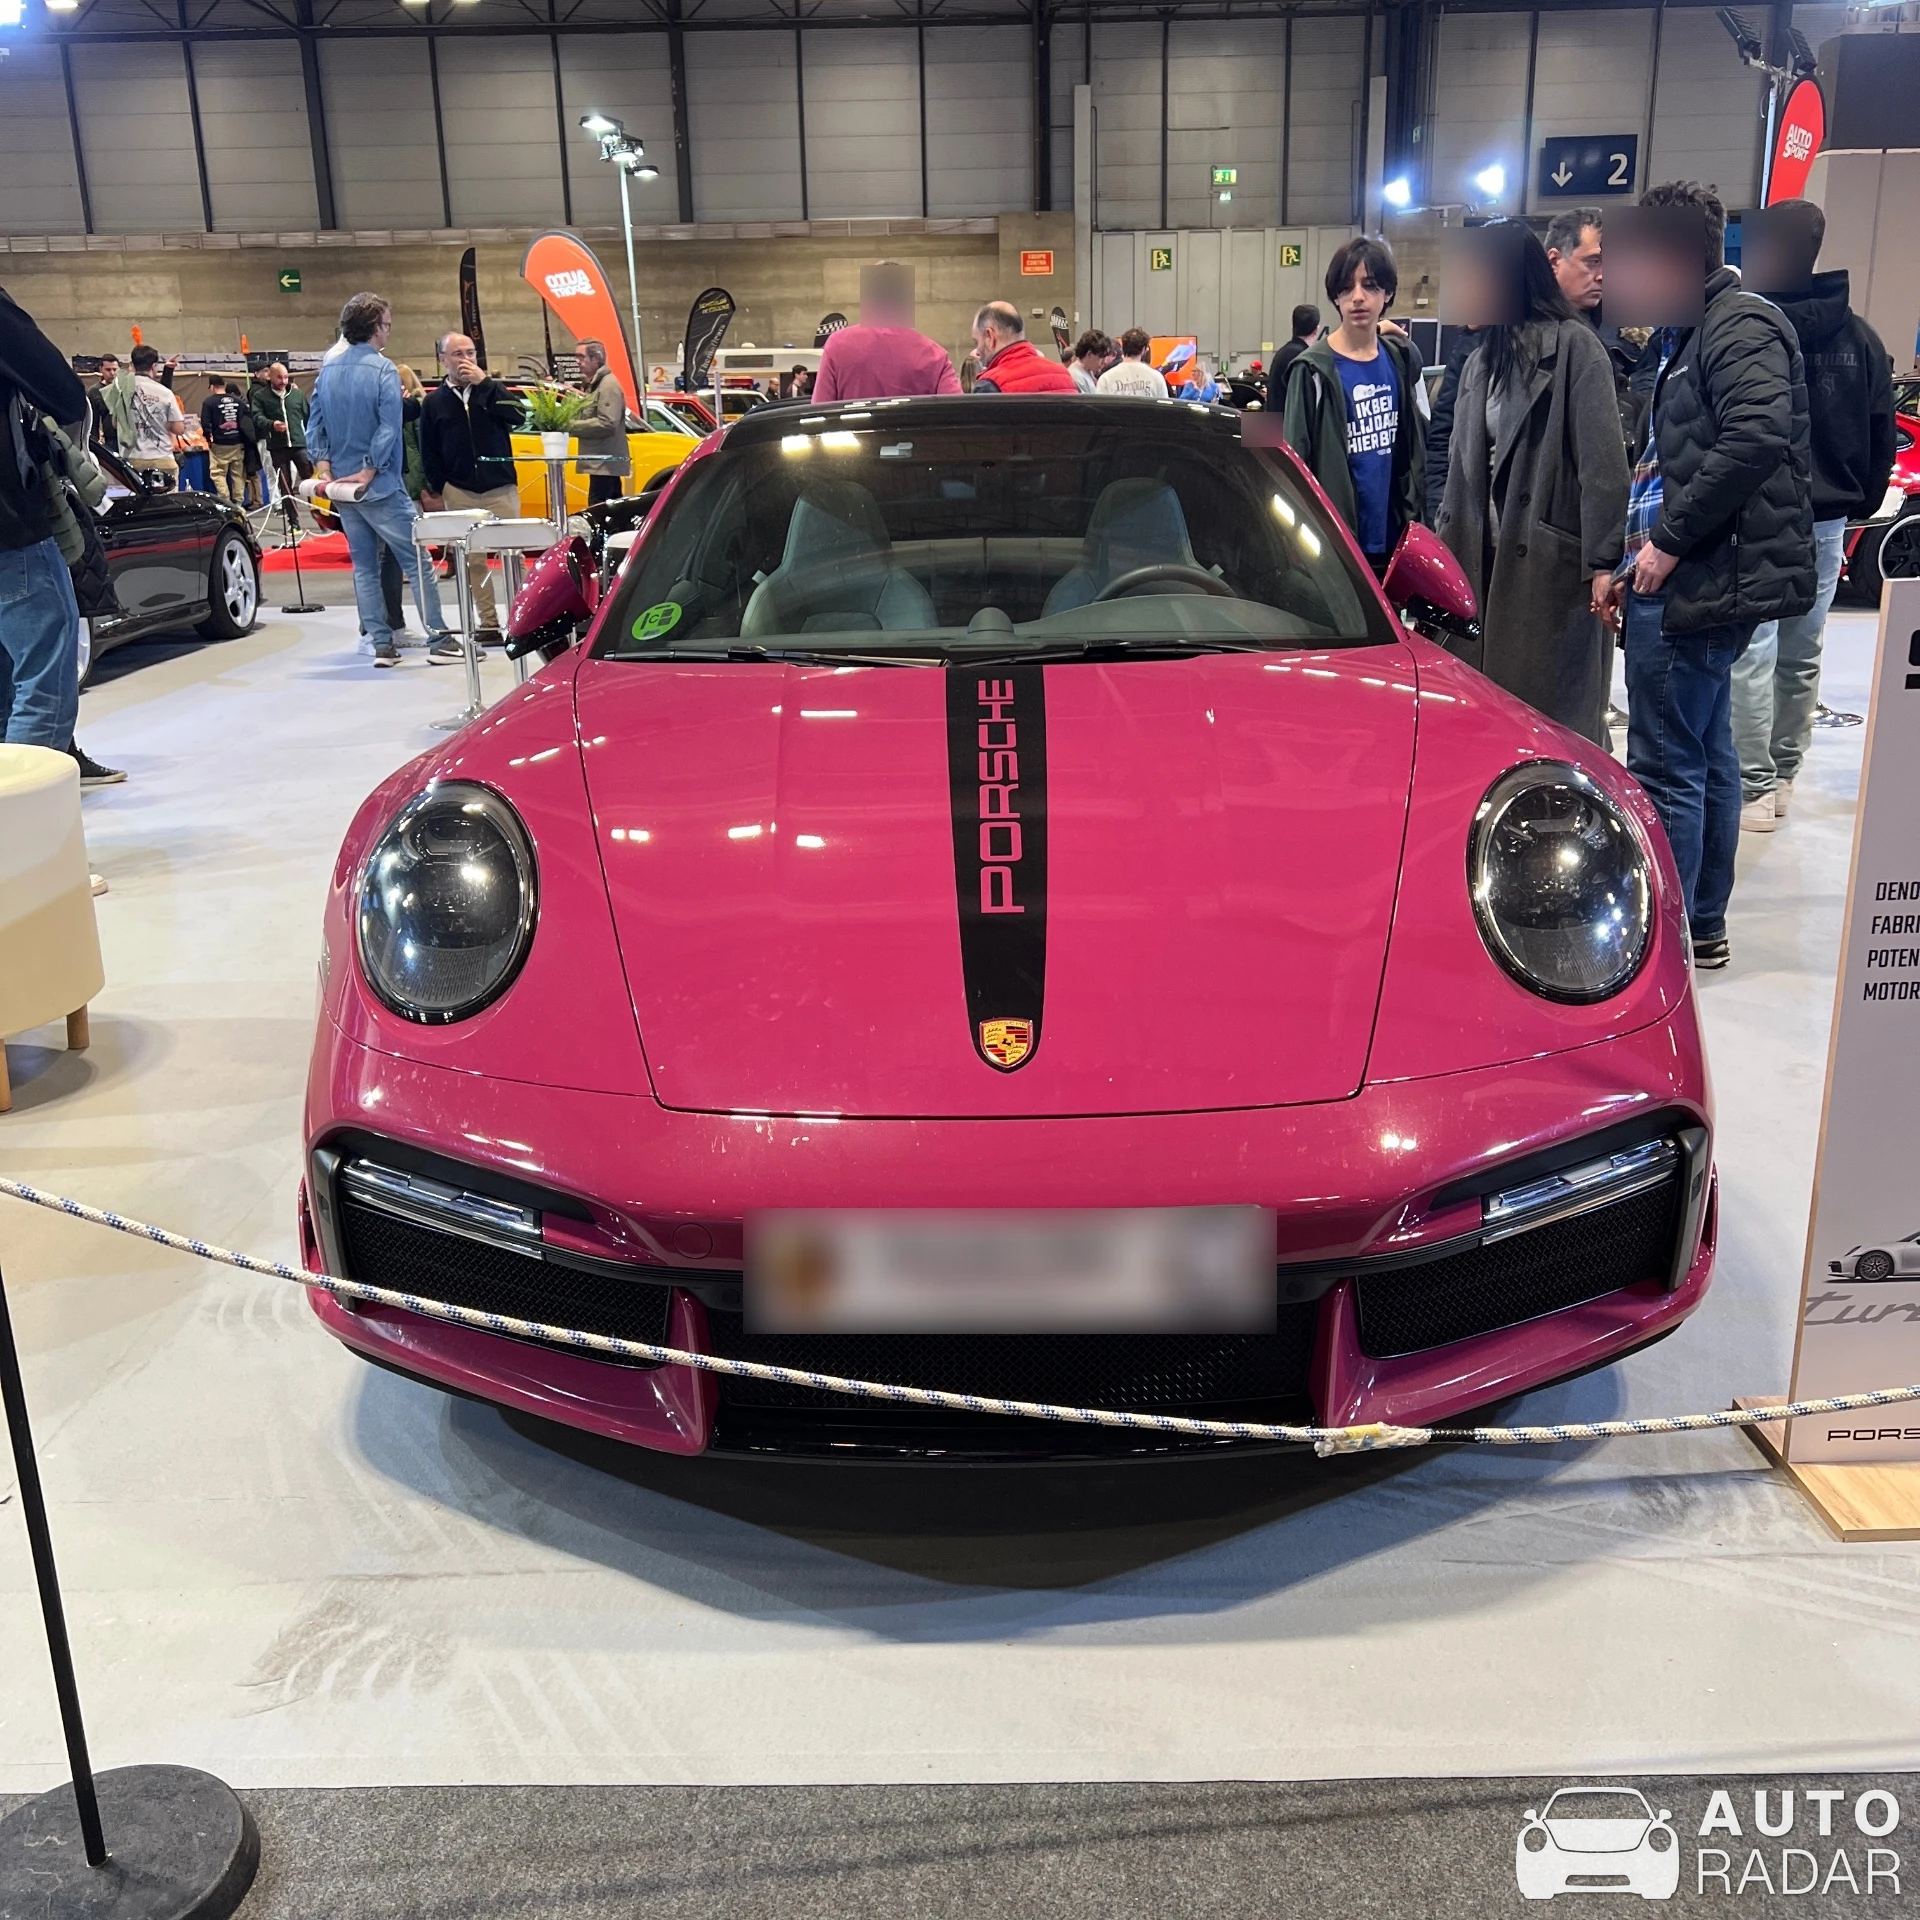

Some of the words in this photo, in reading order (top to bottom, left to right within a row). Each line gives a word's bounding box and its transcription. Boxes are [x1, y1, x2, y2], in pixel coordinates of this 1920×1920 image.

[1787, 124, 1812, 149] AUTO
[1783, 140, 1809, 162] SPORT
[1608, 153, 1627, 185] 2
[978, 679, 1025, 914] PORSCHE
[1875, 881, 1920, 901] DENO
[1867, 949, 1920, 968] POTEN
[1863, 982, 1920, 1001] MOTOR
[1827, 1428, 1920, 1441] PORS
